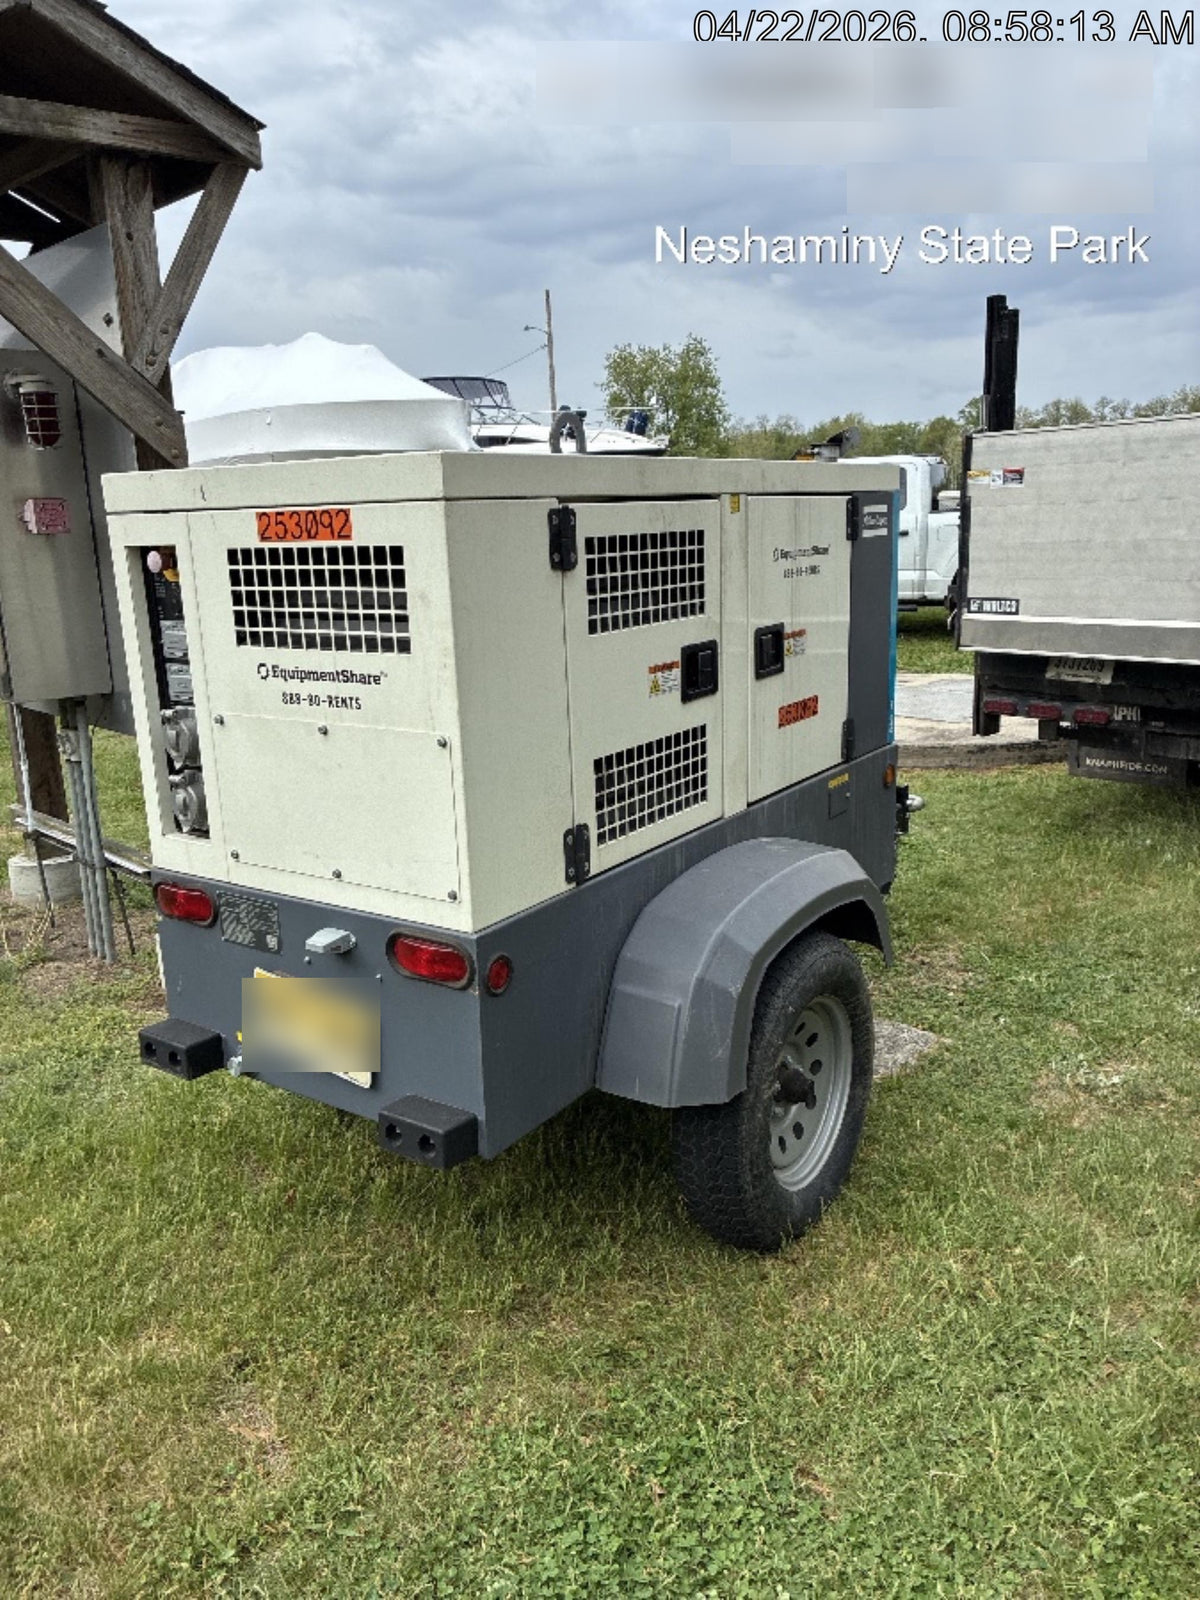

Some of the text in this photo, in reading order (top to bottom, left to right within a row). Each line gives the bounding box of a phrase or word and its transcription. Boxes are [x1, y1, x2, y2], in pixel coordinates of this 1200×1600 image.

[258, 508, 351, 540] 253092
[271, 664, 381, 685] EquipmentShare
[282, 691, 362, 710] 888-80-RENTS
